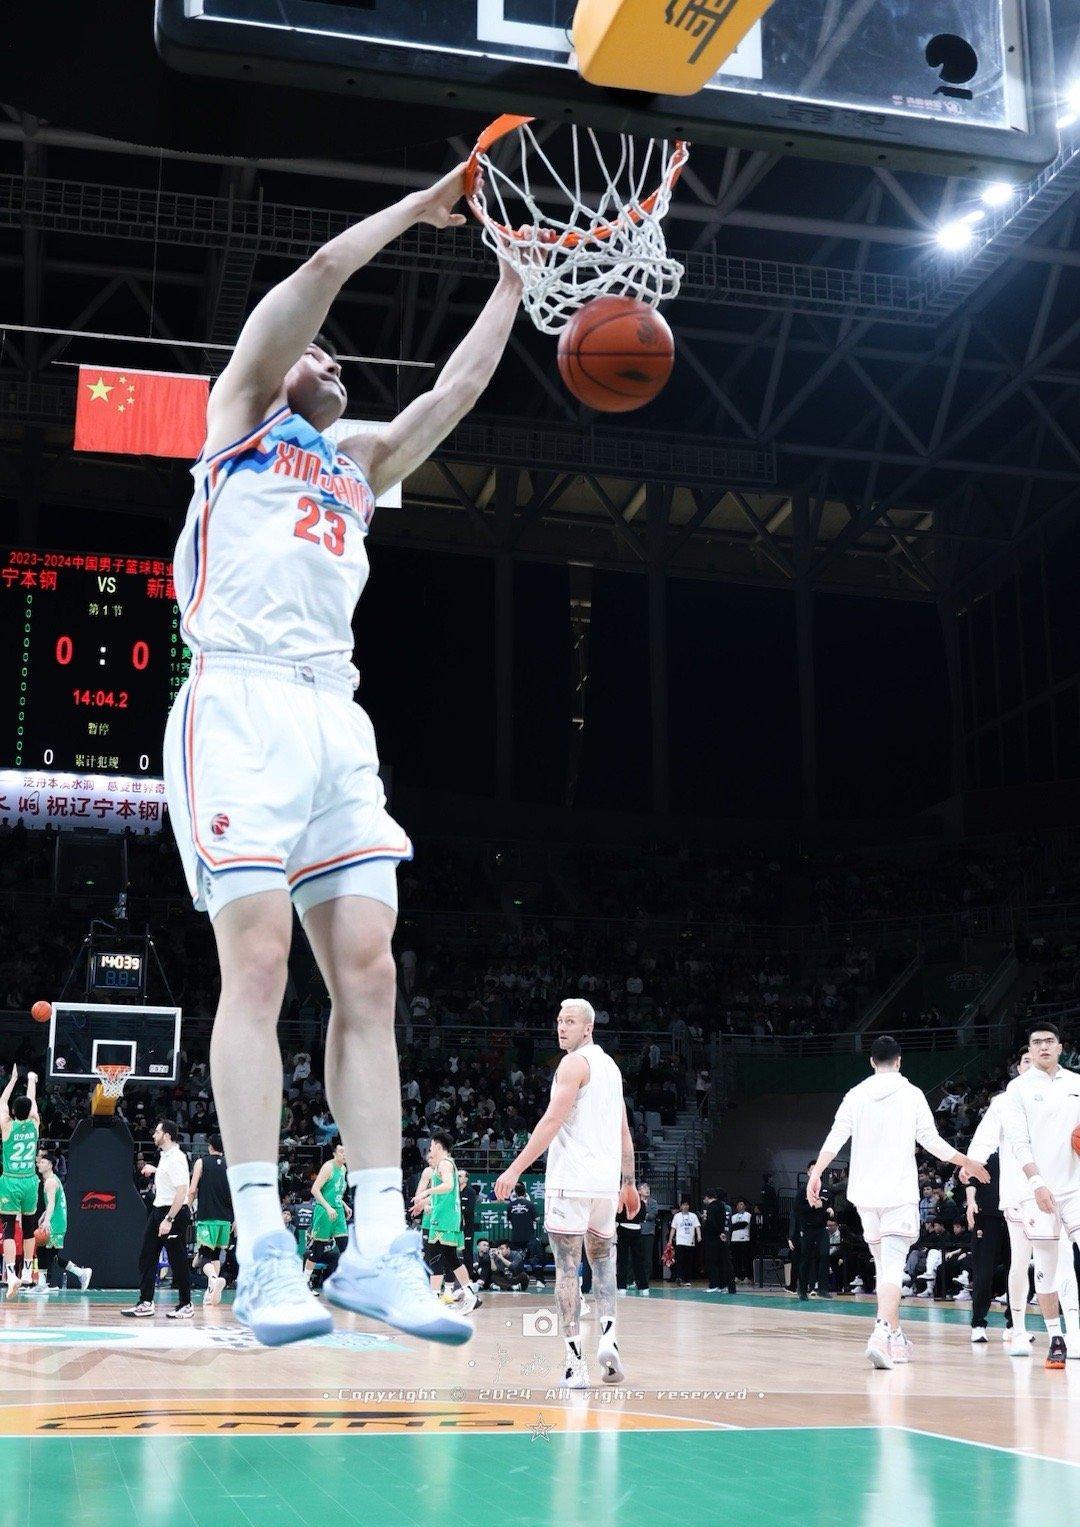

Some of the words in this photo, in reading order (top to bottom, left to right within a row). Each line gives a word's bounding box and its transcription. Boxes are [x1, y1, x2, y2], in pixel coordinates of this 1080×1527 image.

[294, 496, 347, 557] 23
[2, 568, 58, 591] 宁本钢
[97, 576, 117, 594] VS
[55, 635, 74, 666] 0
[132, 640, 150, 671] 0
[73, 690, 128, 708] 14:04.2
[44, 749, 54, 765] 0
[139, 754, 149, 770] 0
[9, 1142, 36, 1161] 22
